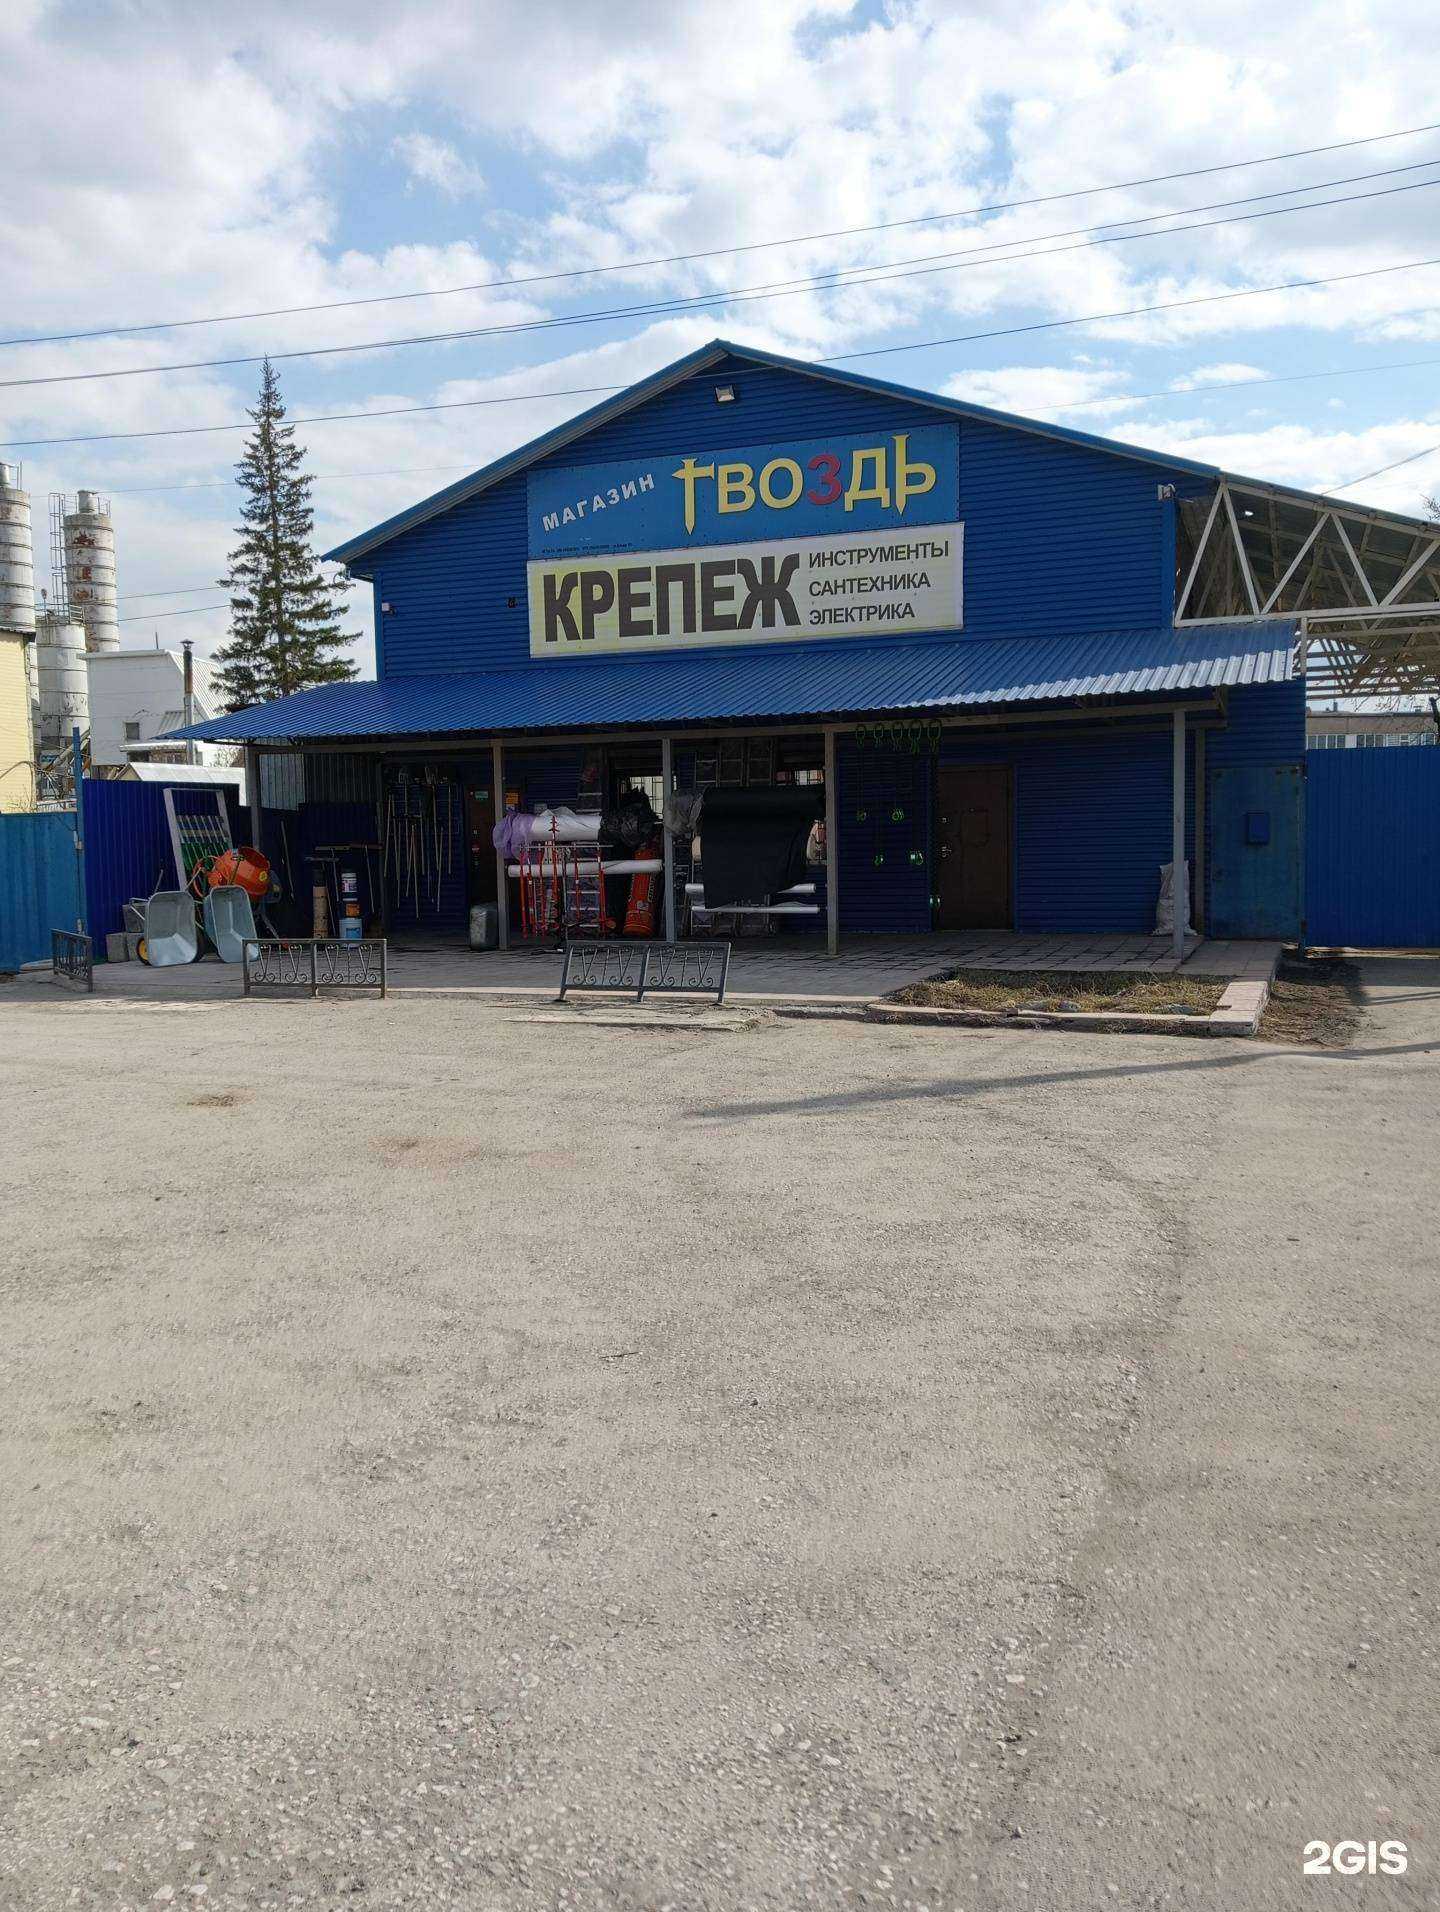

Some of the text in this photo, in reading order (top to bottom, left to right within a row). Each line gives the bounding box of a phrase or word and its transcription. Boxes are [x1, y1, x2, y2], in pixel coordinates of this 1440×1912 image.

[542, 473, 655, 533] МАГАЗИН
[671, 434, 937, 536] ГВОЗДЬ
[809, 540, 949, 569] ИНСТРУМЕНТЫ
[543, 553, 801, 642] КРЕПЕЖ
[809, 571, 931, 597] САНТЕХНИКА
[809, 603, 915, 626] ЭЛЕКТРИКА
